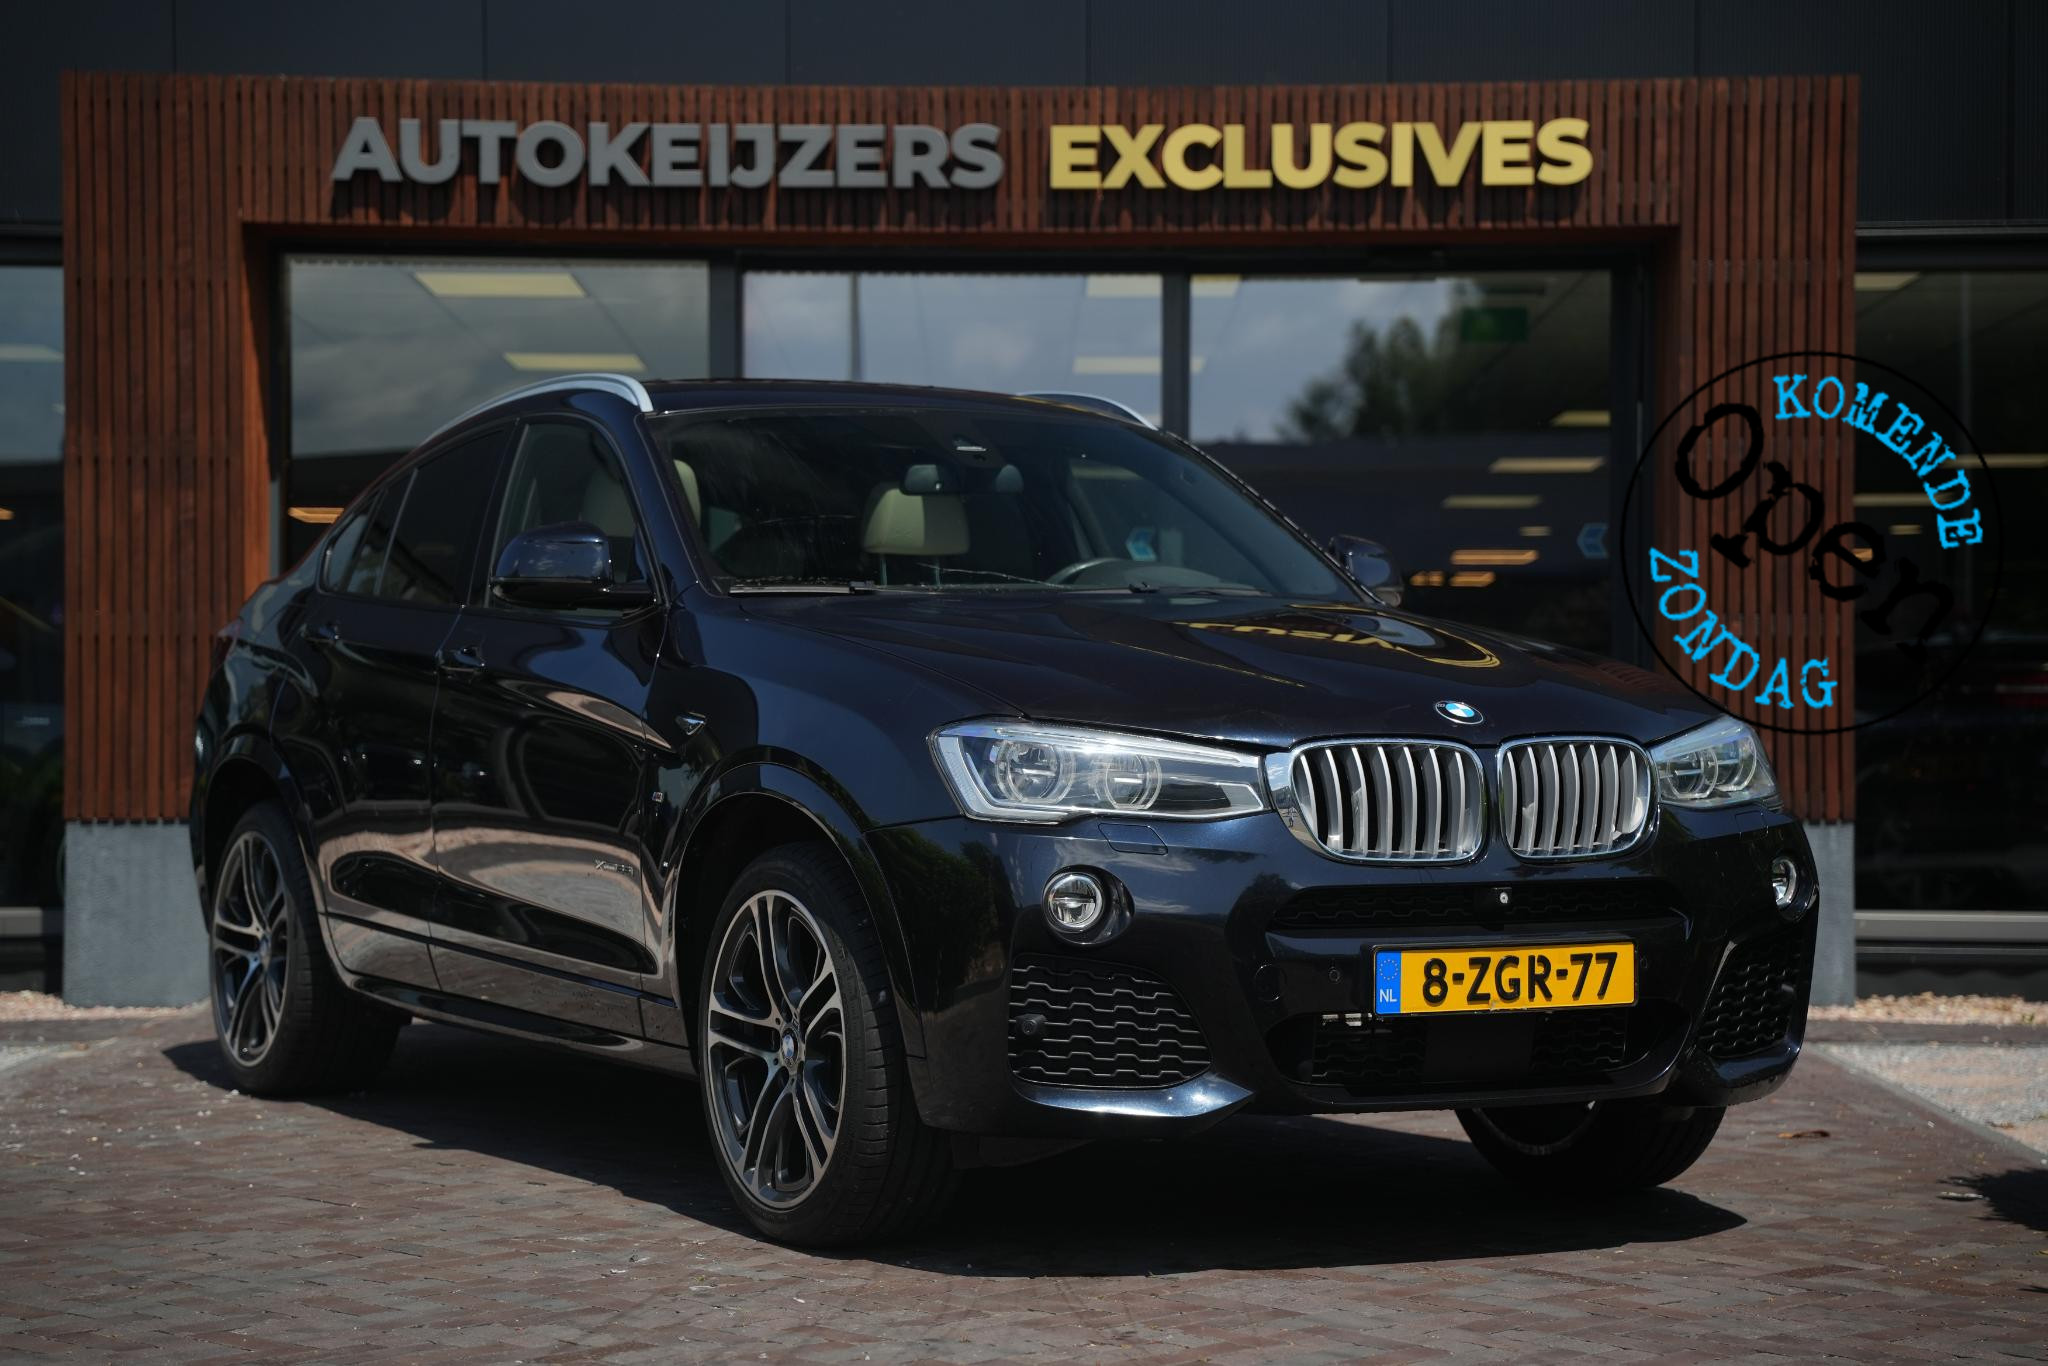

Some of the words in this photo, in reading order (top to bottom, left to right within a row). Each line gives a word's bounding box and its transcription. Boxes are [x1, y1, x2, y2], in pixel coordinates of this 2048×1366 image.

[330, 116, 1004, 190] AUTOKEIJZERS
[1049, 117, 1594, 191] EXCLUSIVES
[1379, 988, 1397, 1003] NL
[1422, 952, 1618, 1004] 8-ZGR-77
